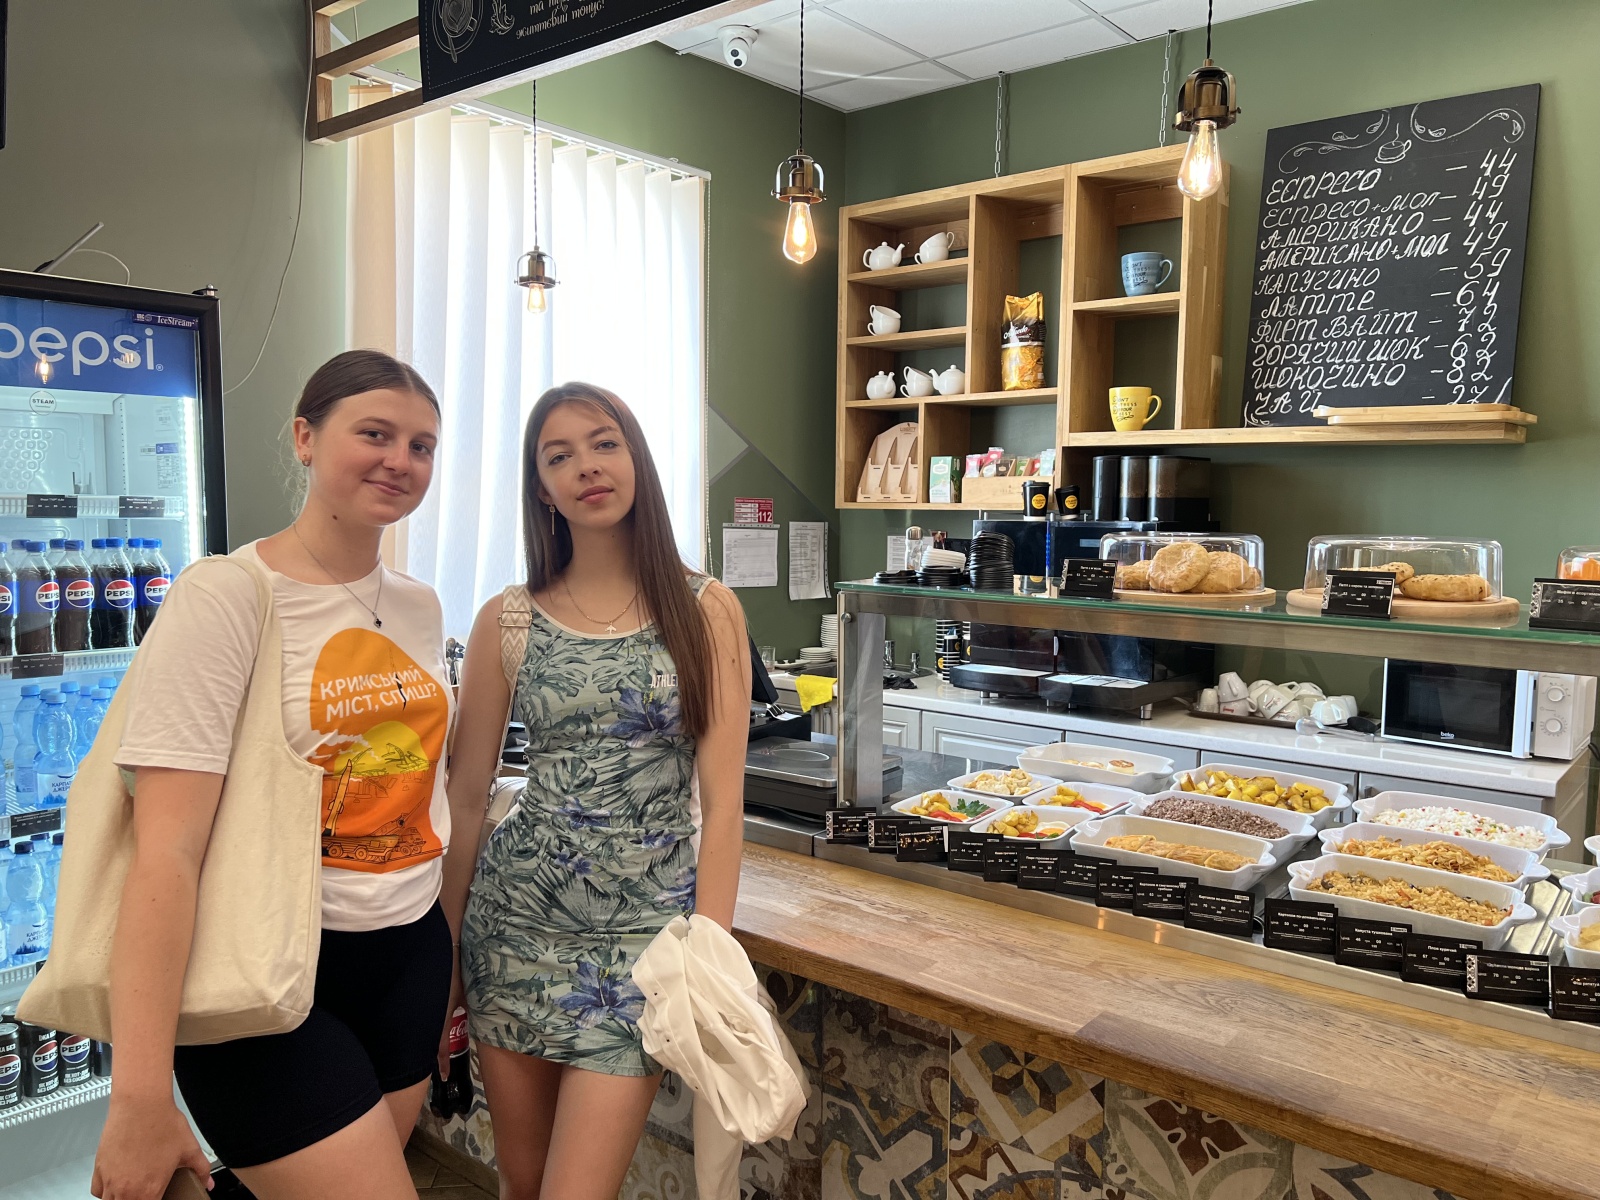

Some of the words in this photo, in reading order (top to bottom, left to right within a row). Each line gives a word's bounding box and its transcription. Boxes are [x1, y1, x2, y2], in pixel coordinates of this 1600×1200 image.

[758, 511, 773, 522] 112
[68, 590, 93, 598] PEPSI
[107, 589, 133, 597] PEPSI
[320, 664, 424, 701] КРИМСЬКИЙ
[326, 693, 379, 723] МІСТ,
[379, 682, 438, 705] СПИШ?
[1440, 730, 1455, 738] beko
[0, 1062, 20, 1075] EPSI
